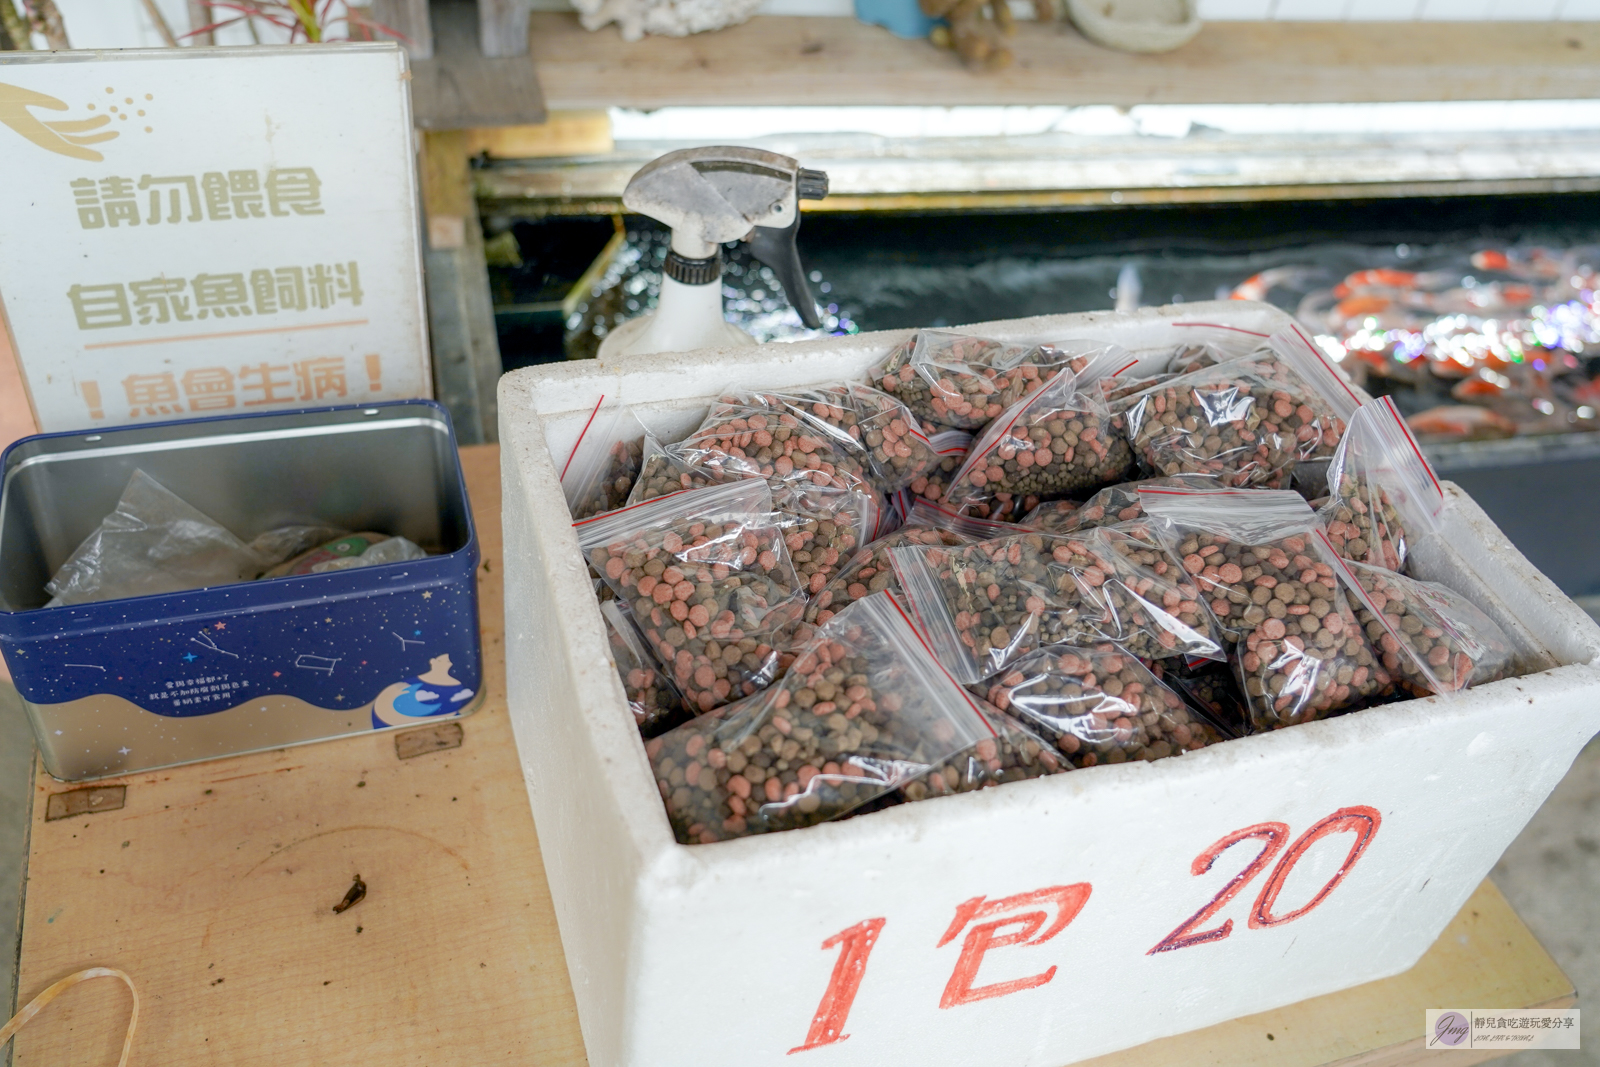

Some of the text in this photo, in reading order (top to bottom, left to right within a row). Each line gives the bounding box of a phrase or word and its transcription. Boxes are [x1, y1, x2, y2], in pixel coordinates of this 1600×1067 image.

[70, 167, 325, 229] 請勿餵食
[66, 261, 364, 330] 自家魚飼料
[1146, 805, 1381, 956] 20
